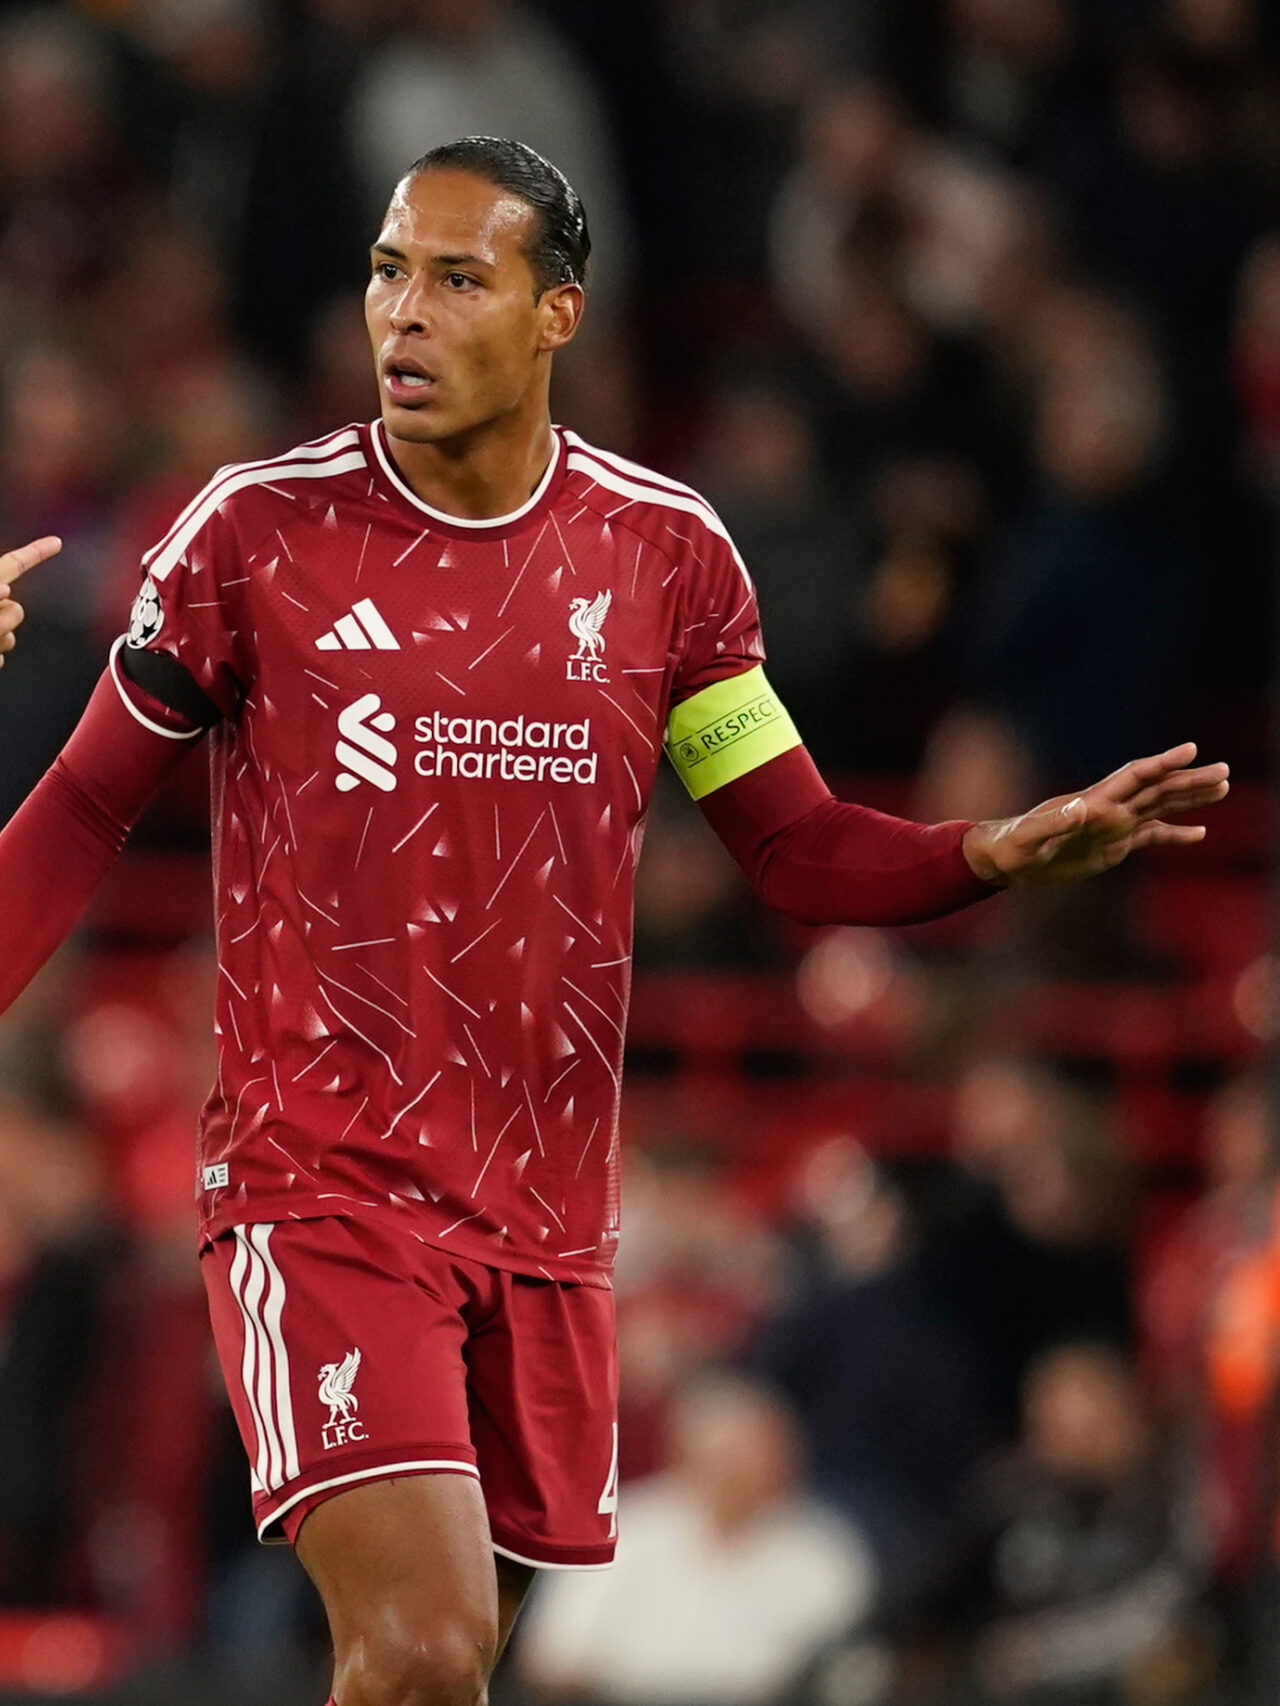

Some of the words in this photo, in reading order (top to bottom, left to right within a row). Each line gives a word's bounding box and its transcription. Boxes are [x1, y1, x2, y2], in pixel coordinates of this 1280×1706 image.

[566, 661, 610, 683] L.F.C.
[414, 711, 590, 750] standard
[701, 699, 776, 750] RESPECT
[414, 745, 597, 784] chartered
[321, 1422, 369, 1450] L.F.C.
